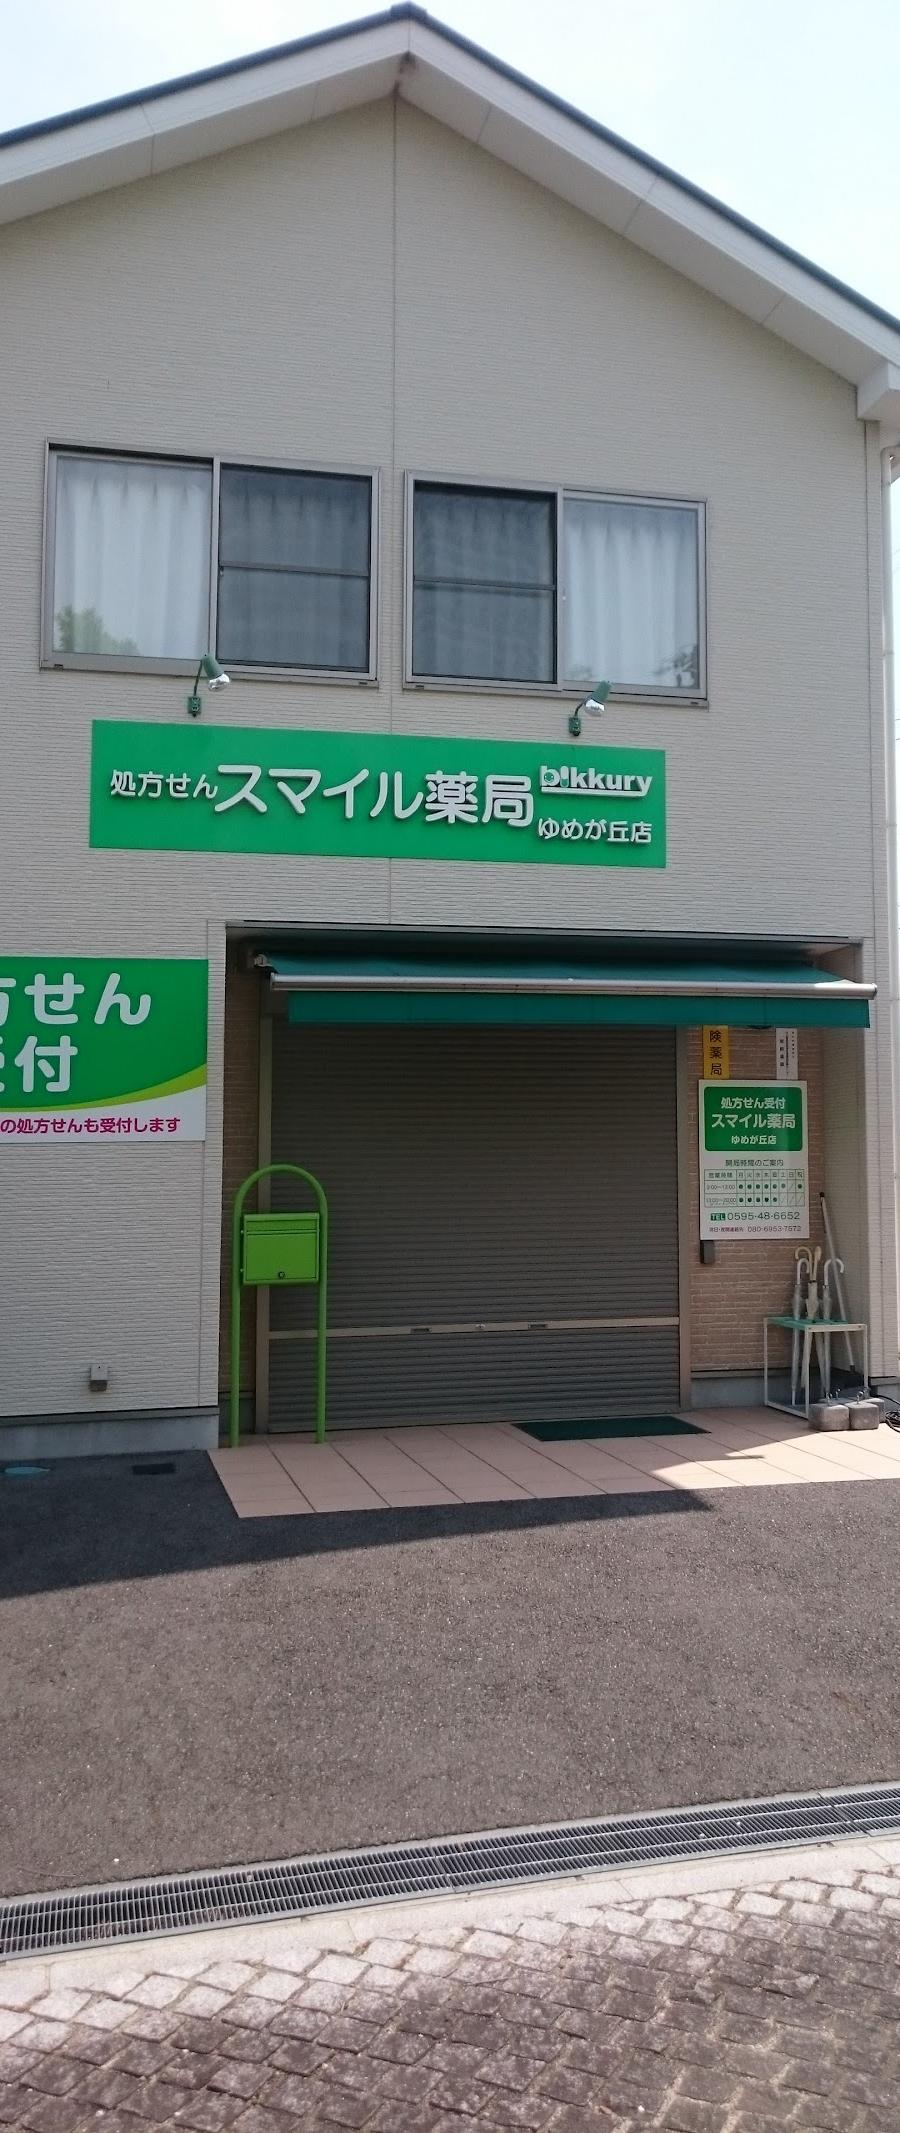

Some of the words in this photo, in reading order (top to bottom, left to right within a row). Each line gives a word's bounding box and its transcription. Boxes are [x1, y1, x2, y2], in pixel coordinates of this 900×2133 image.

[540, 765, 653, 797] bikkury
[110, 769, 218, 800] 処方せん
[214, 764, 535, 827] スマイル薬局
[538, 817, 653, 843] ゆめが丘店
[720, 1096, 787, 1110] 処方せん受付
[0, 1117, 181, 1134] の処方せんも受付します
[711, 1113, 796, 1129] スマイル薬局
[731, 1135, 777, 1145] ゆめが丘店
